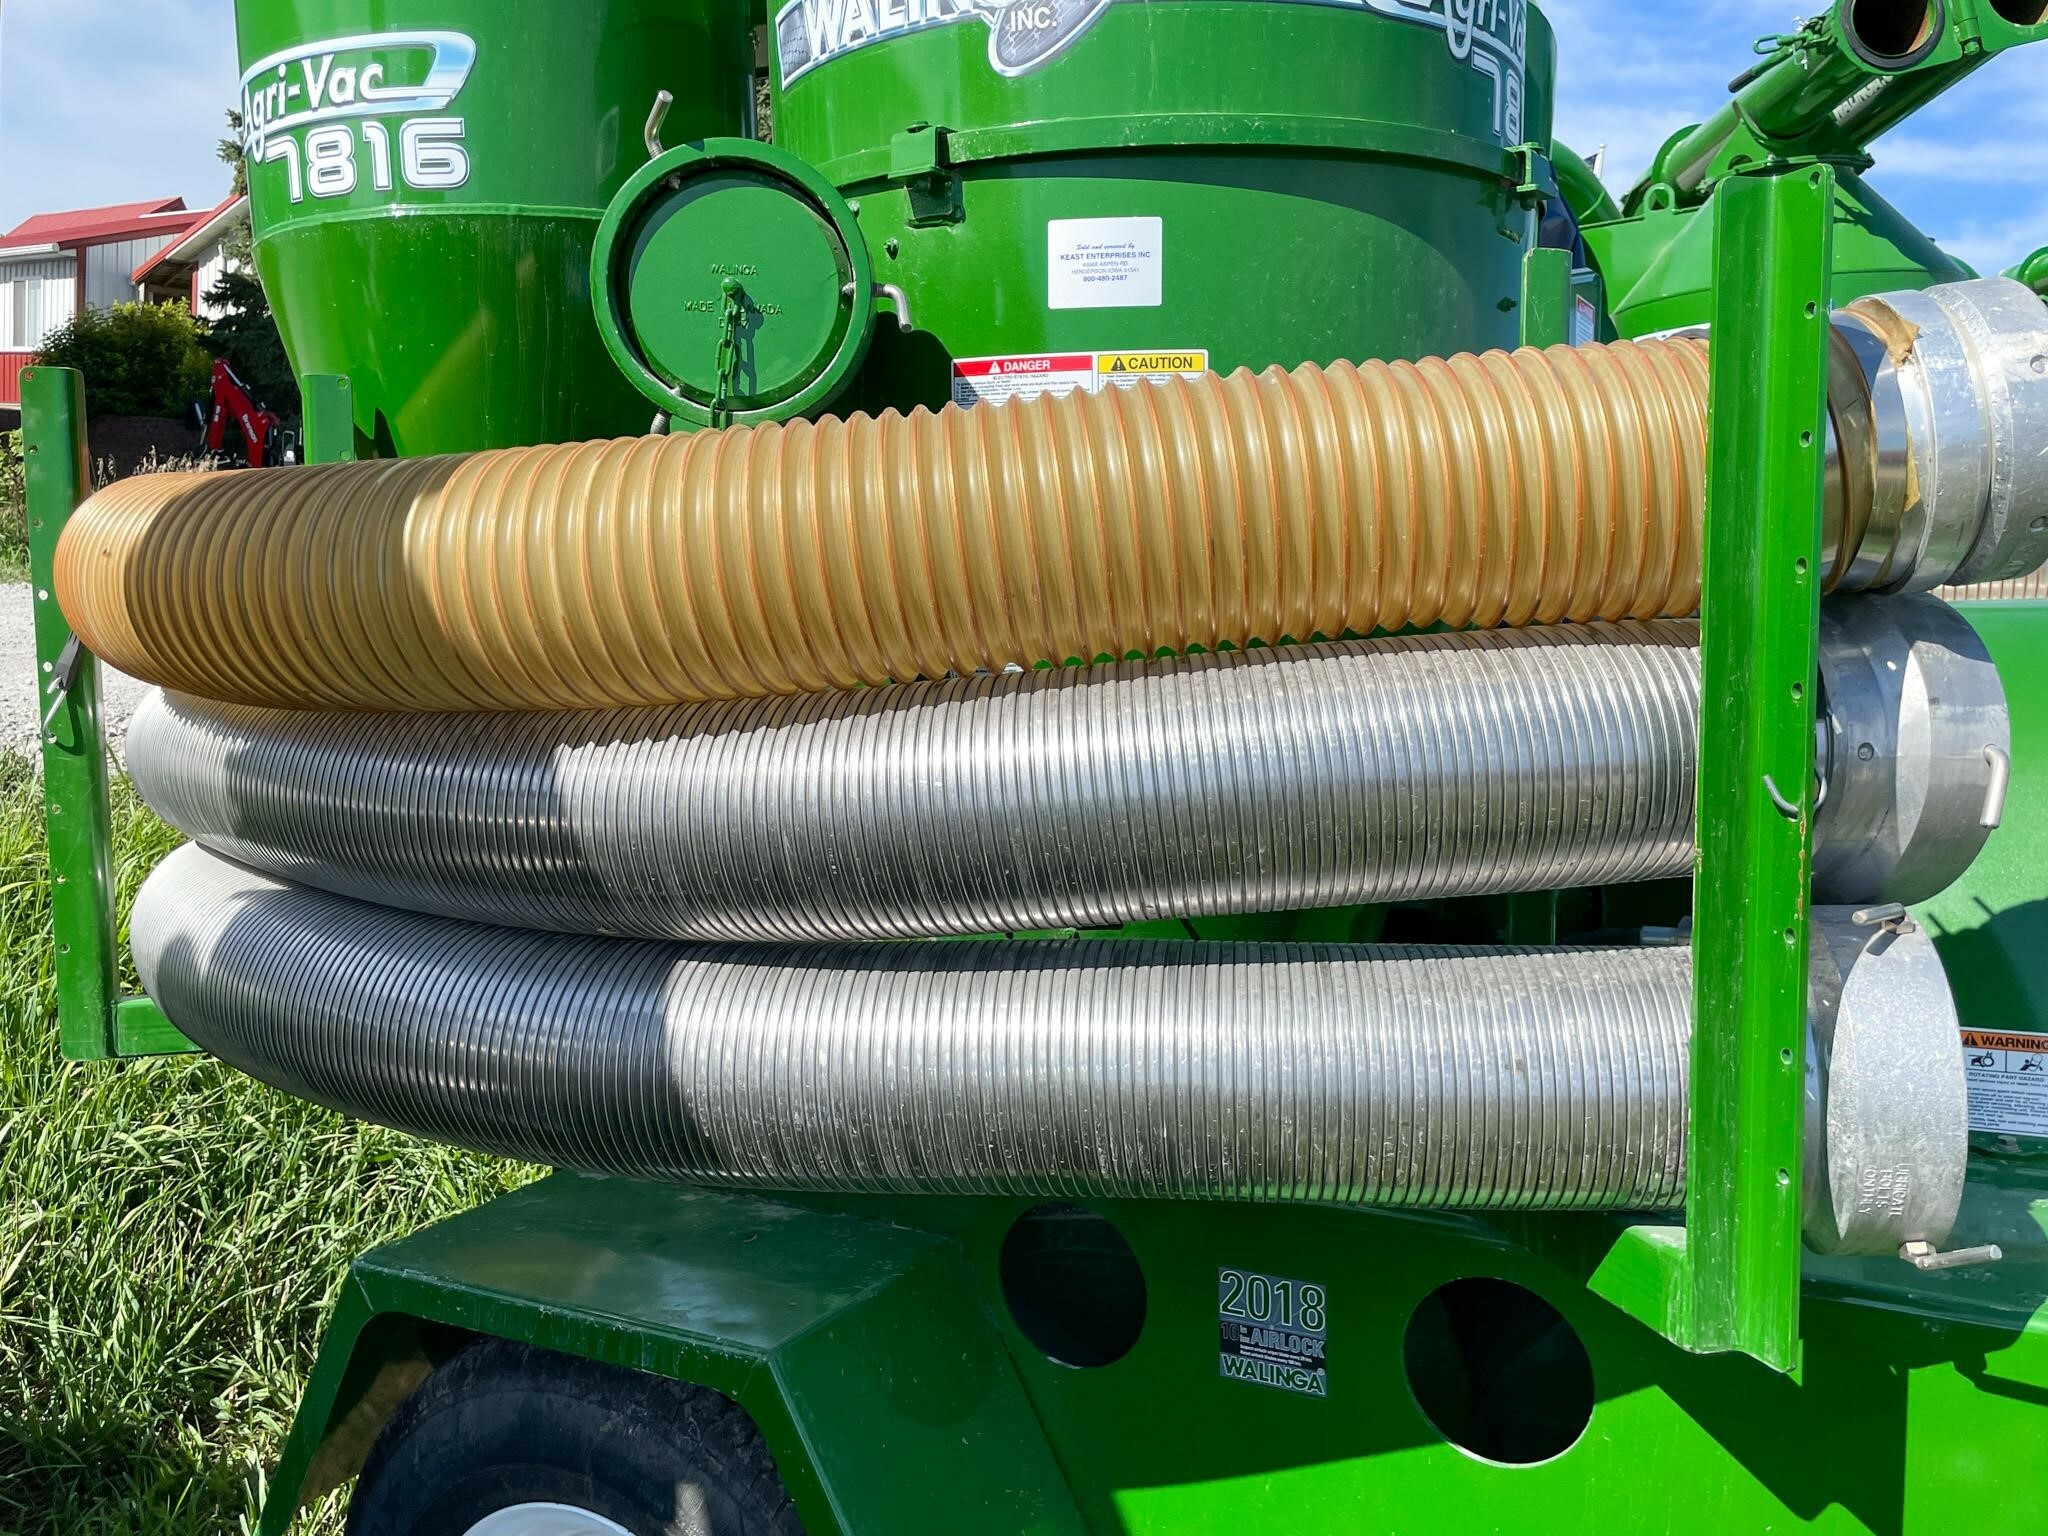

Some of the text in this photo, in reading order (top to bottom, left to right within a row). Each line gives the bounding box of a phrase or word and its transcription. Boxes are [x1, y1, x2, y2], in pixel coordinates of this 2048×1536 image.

[1010, 7, 1058, 32] INC.
[243, 53, 456, 164] Agri-Vac
[265, 118, 470, 204] 7816
[1060, 253, 1084, 261] KEAST
[1086, 252, 1137, 260] ENTERPRISES
[684, 300, 715, 313] MADE
[1003, 360, 1051, 372] DANGER
[1128, 356, 1193, 370] CAUTION
[1220, 1270, 1326, 1332] 2018
[1250, 1327, 1326, 1359] AIRLOCK
[1220, 1353, 1326, 1396] WALINGA
